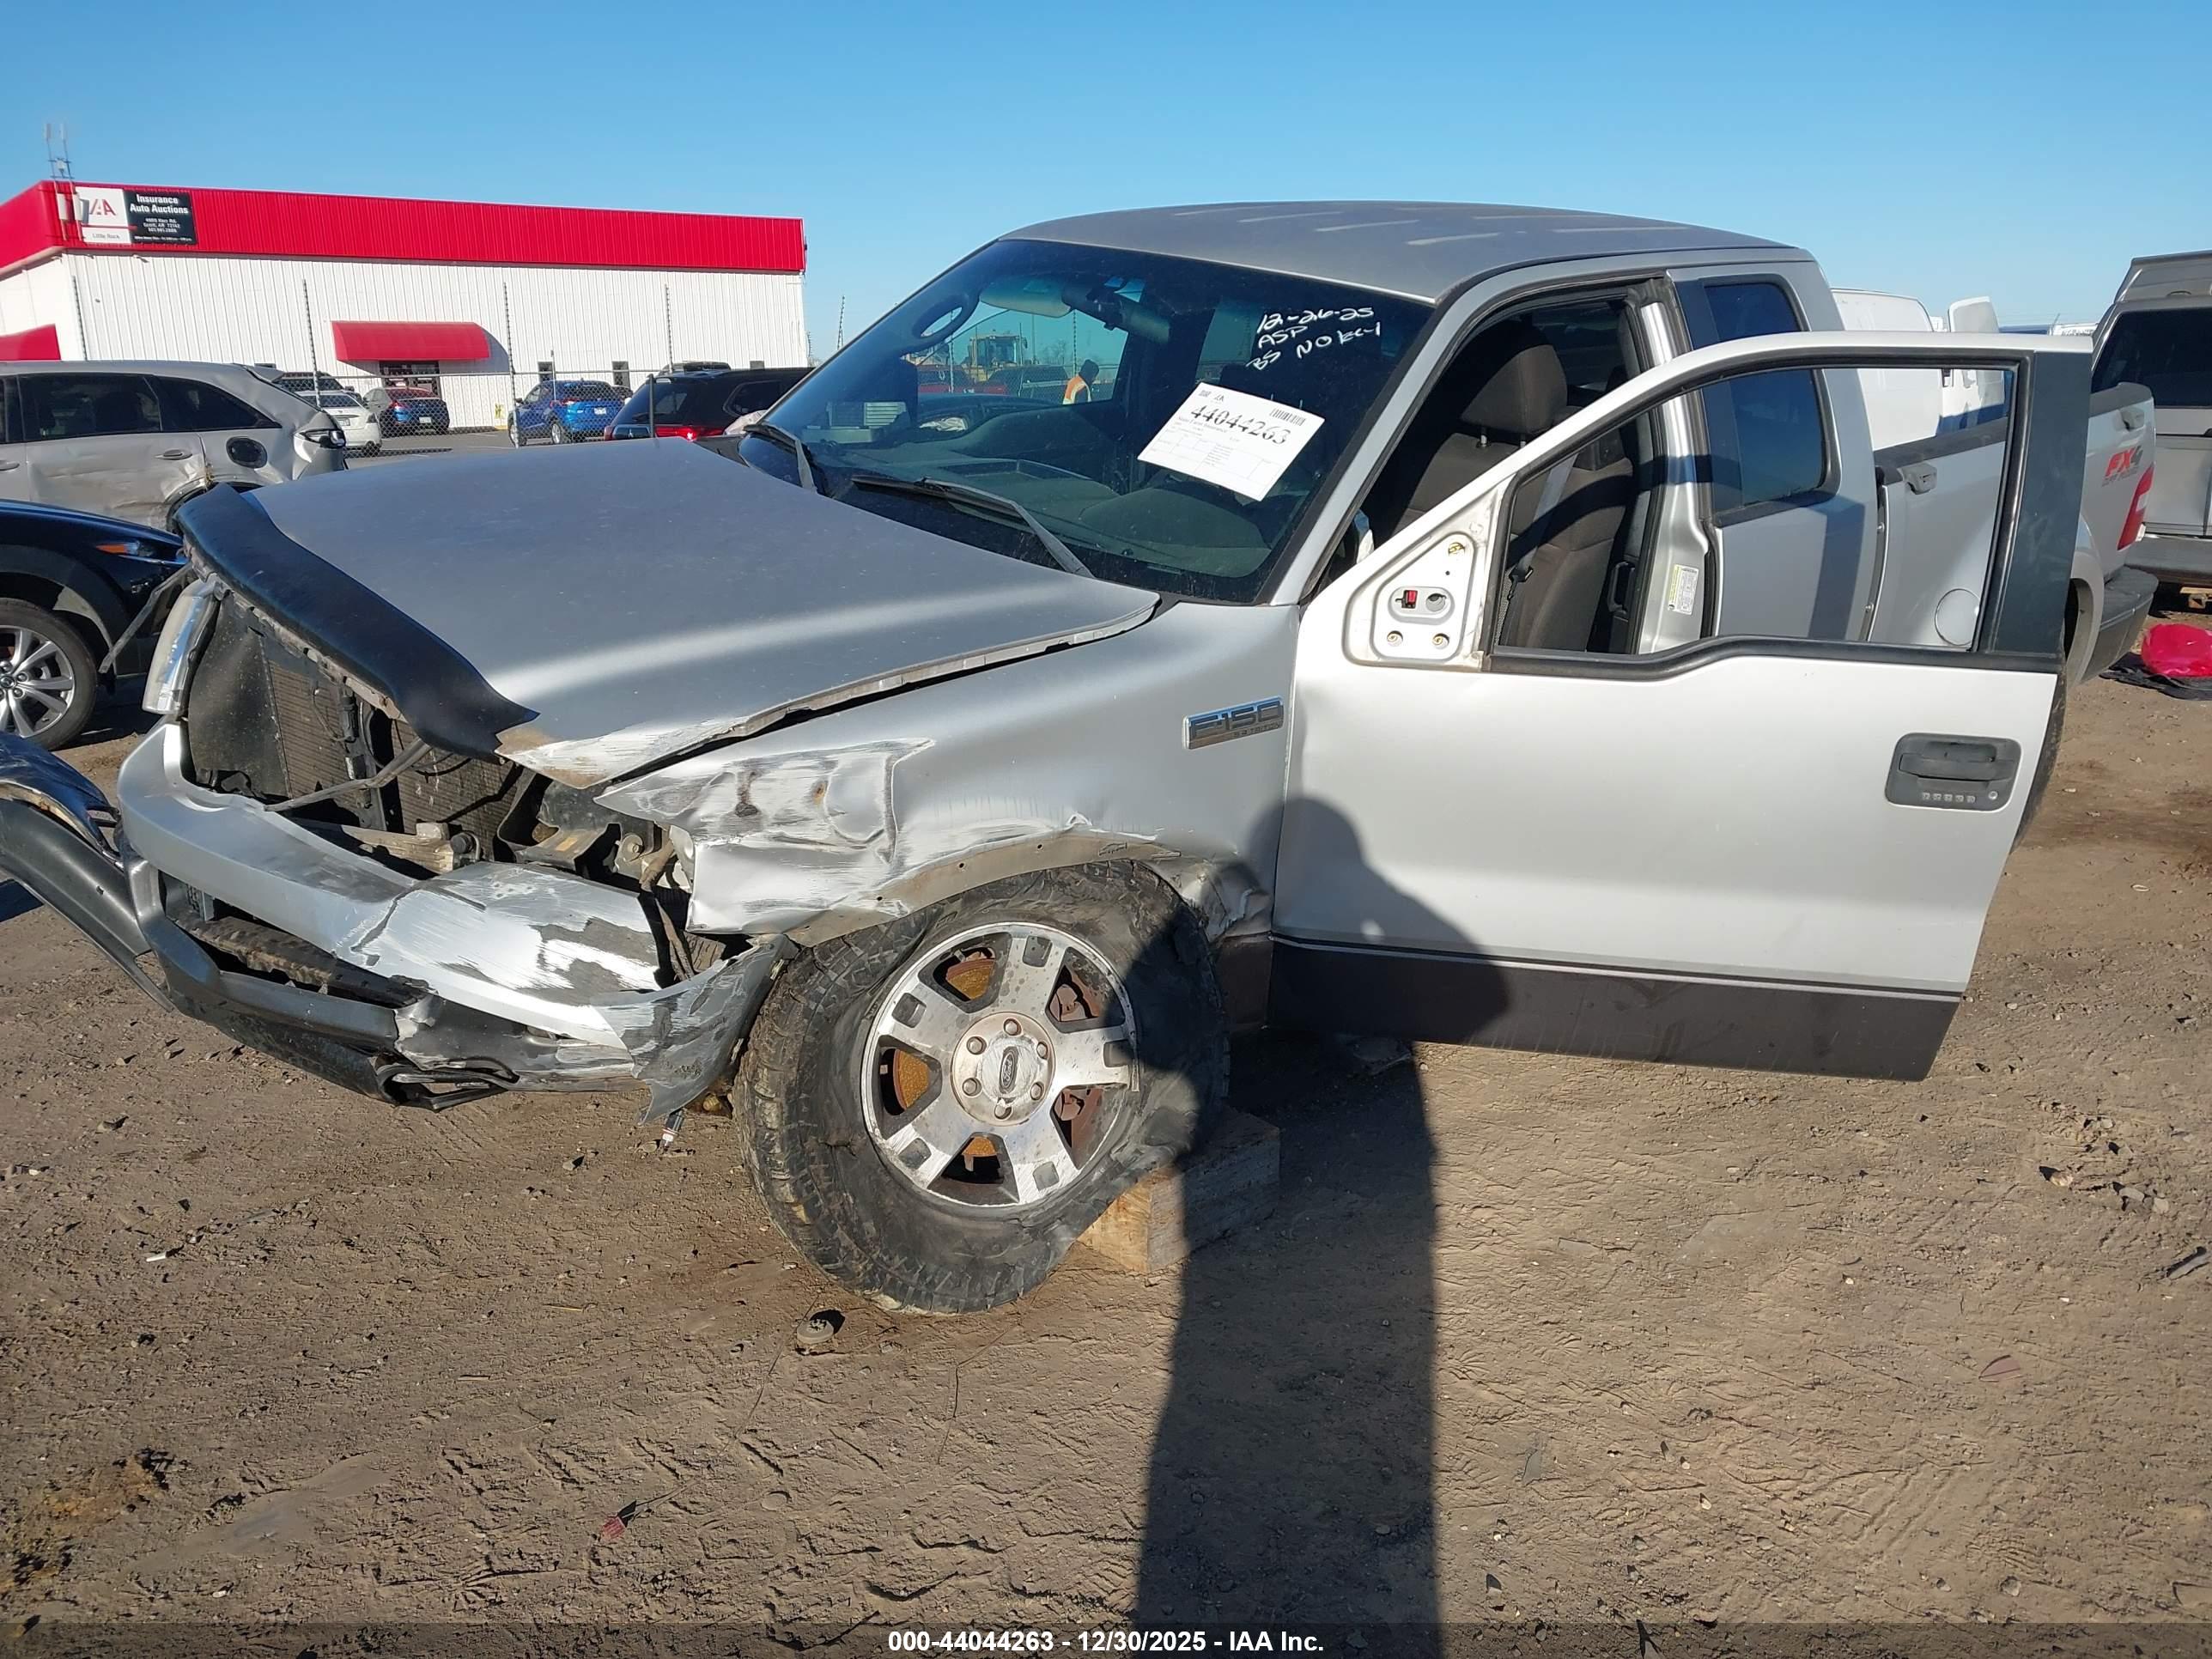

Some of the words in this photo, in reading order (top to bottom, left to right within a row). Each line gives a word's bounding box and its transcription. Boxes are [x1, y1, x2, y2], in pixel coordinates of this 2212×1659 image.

[130, 204, 150, 213] Auto
[151, 204, 189, 214] Auctions
[136, 193, 179, 204] Insurance
[1256, 307, 1375, 334] 12-26-25
[1296, 336, 1333, 360] NO
[1190, 404, 1291, 445] 44044263
[2105, 445, 2144, 477] FX4
